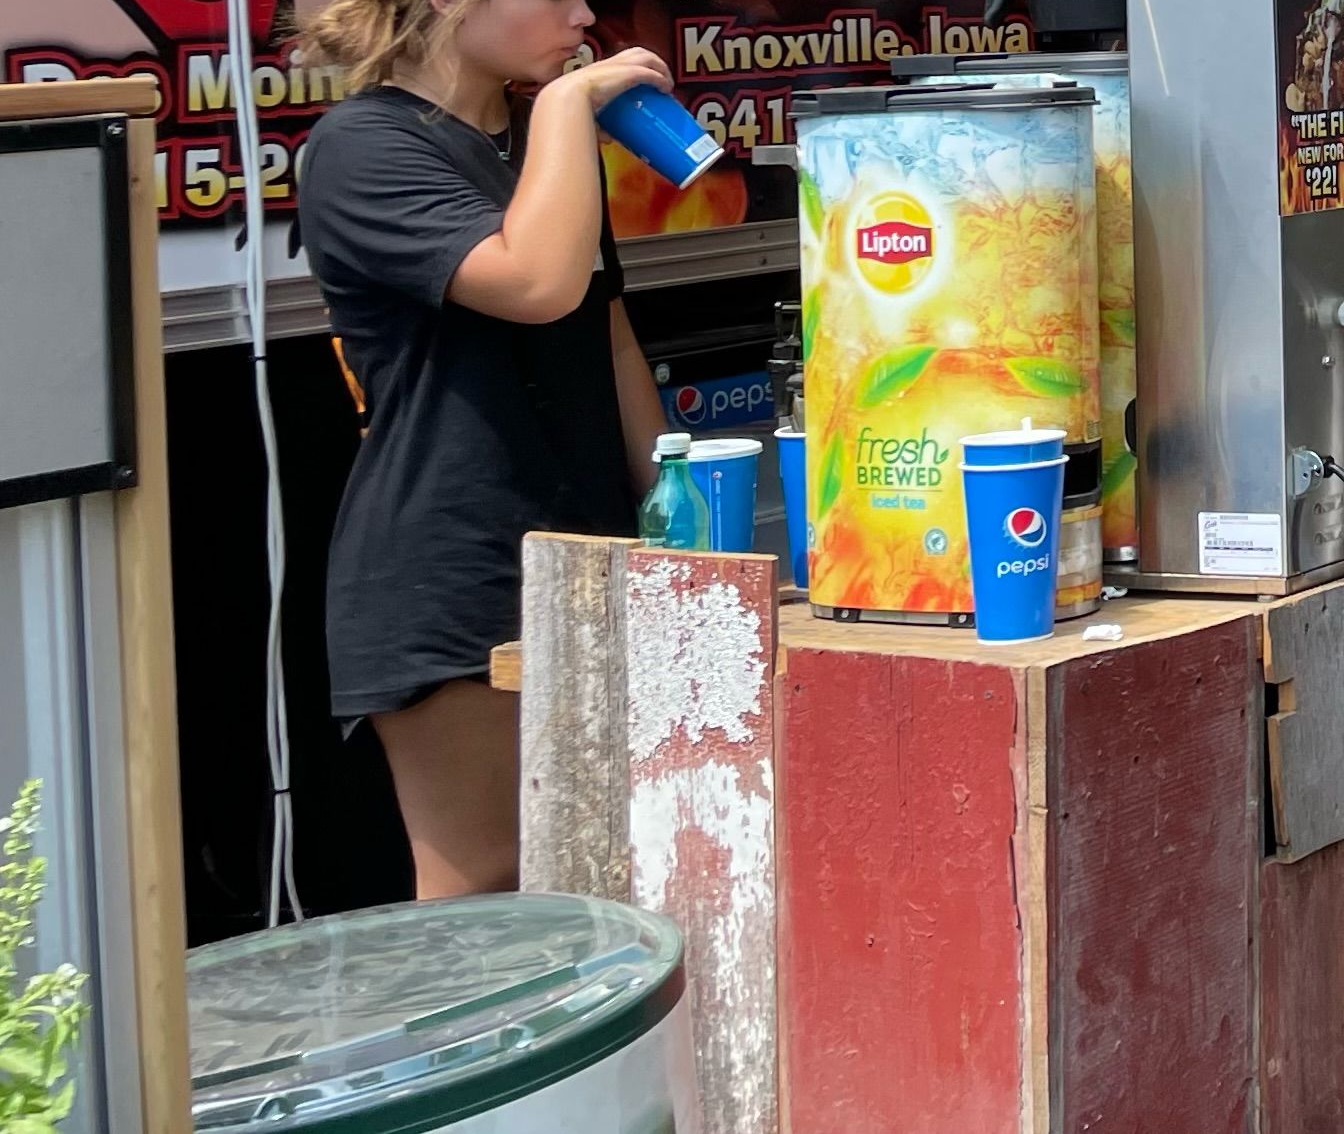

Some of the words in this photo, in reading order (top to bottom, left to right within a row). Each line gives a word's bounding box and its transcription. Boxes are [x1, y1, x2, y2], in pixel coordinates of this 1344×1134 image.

[929, 15, 1030, 55] Iowa
[1291, 113, 1327, 140] "THE
[1297, 146, 1321, 165] NEW
[1322, 144, 1344, 162] FOR
[1305, 165, 1338, 198] '22!
[861, 228, 927, 257] Lipton
[711, 380, 774, 419] peps
[856, 426, 943, 465] fresh
[856, 466, 942, 487] BREWED
[903, 495, 926, 510] tea
[996, 553, 1050, 578] pepsi
